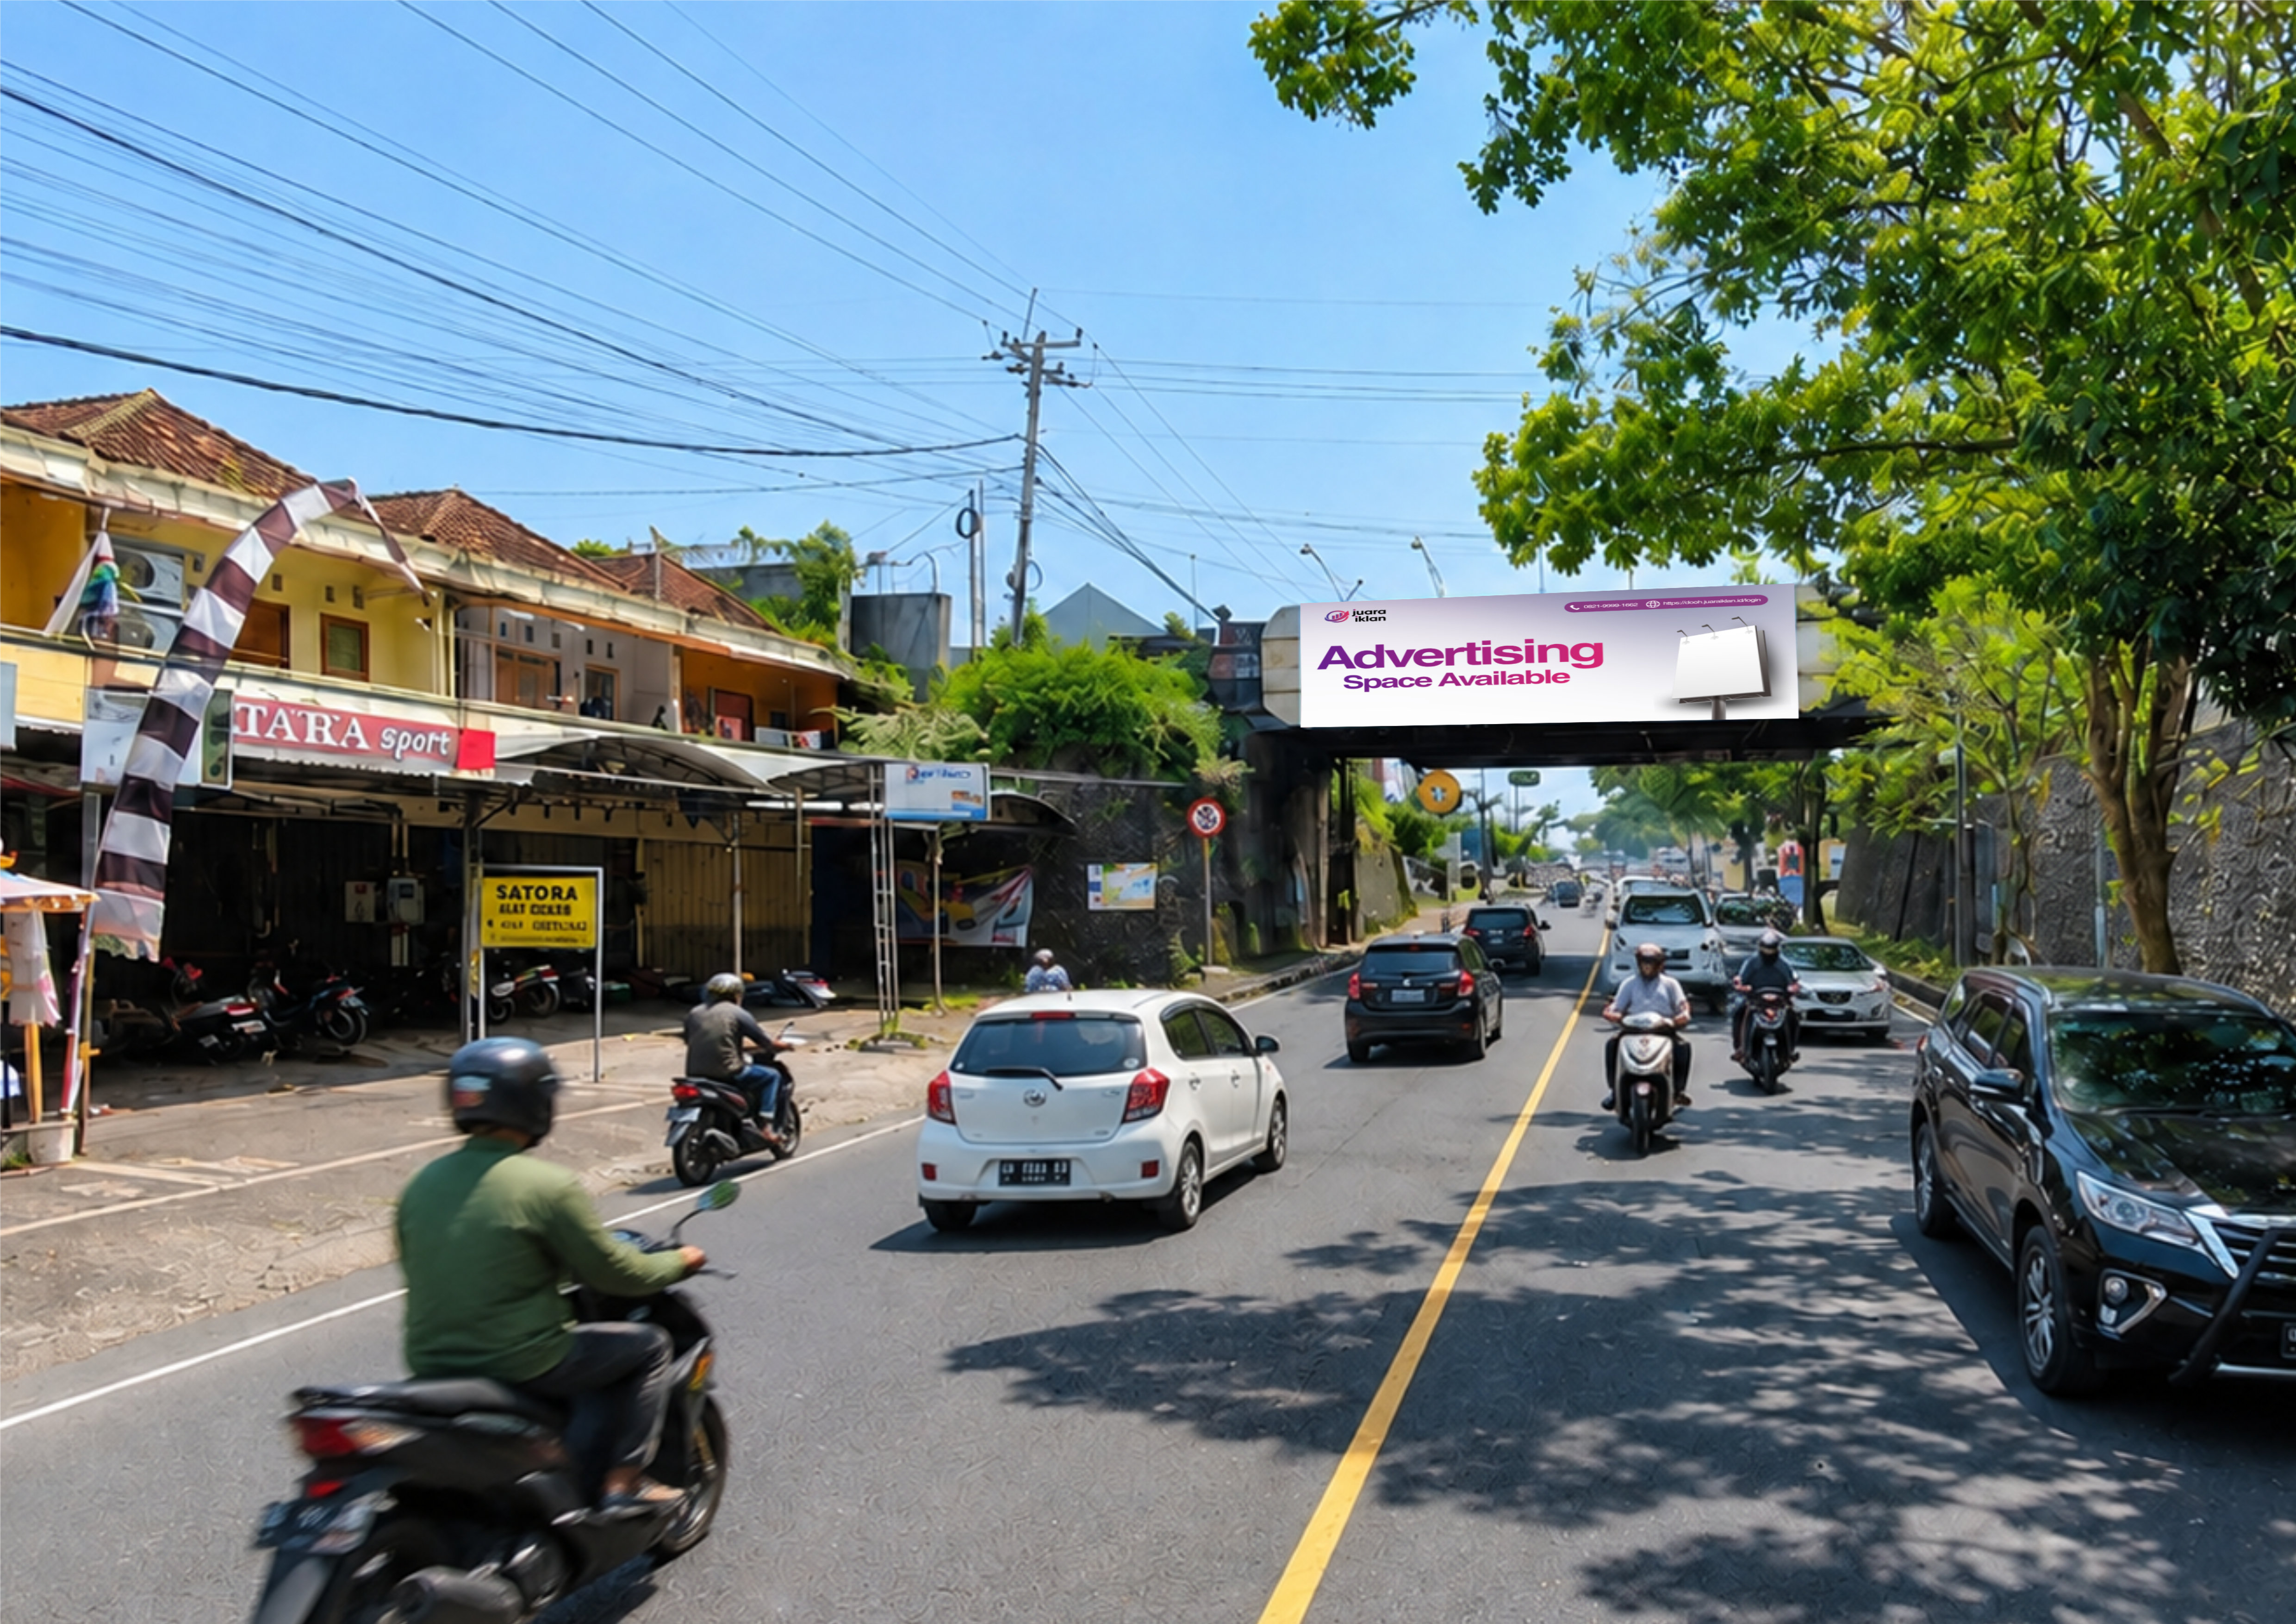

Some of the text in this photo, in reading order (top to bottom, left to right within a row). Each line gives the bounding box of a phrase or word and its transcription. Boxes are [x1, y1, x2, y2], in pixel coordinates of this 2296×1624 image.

[1663, 598, 1761, 606] https://dooh.juaraiklan.id/login
[1317, 638, 1604, 669] Advertising
[1343, 669, 1571, 693] Space Available
[380, 726, 451, 761] sport
[496, 884, 578, 901] SATORA
